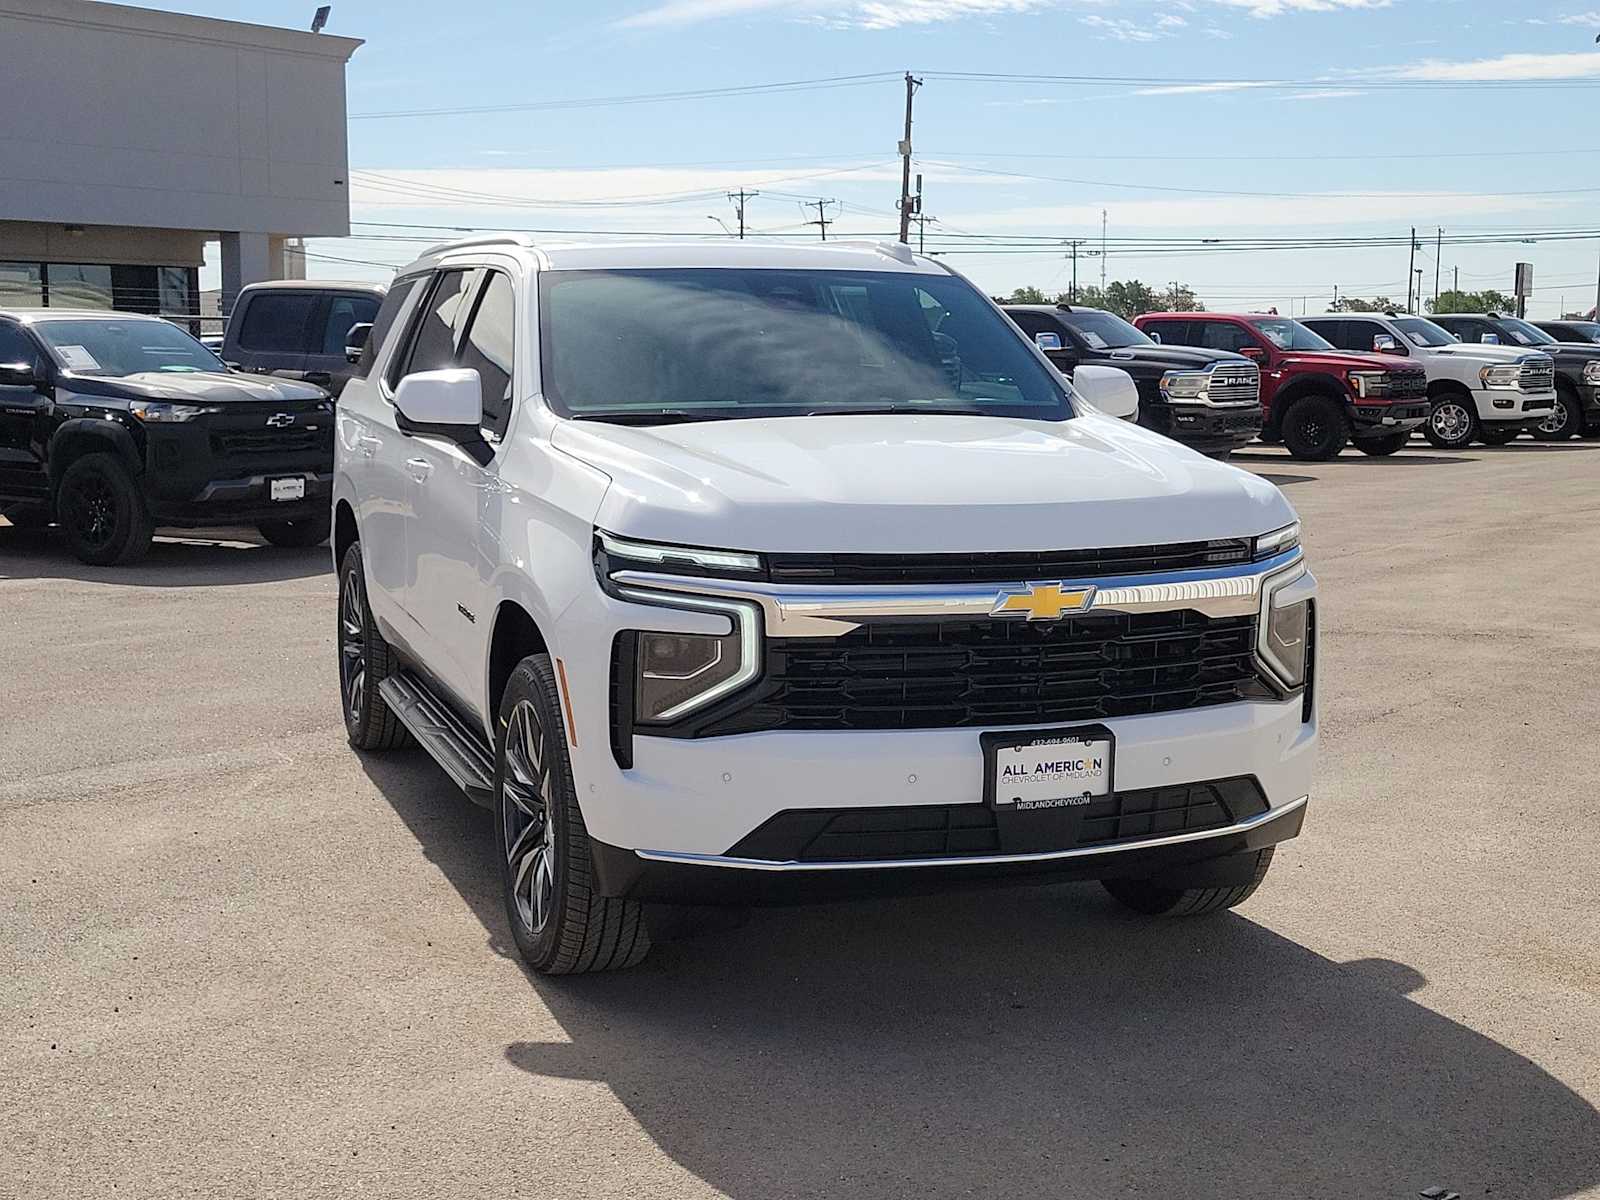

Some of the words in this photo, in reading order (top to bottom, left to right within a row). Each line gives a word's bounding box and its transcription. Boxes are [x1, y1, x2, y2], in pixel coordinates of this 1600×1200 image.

[1001, 773, 1050, 784] CHEVROLET
[1053, 772, 1063, 780] OF
[1065, 769, 1102, 779] MIDLAND
[1003, 764, 1028, 776] ALL
[1016, 796, 1091, 810] MIDLANDCHEVY.COM
